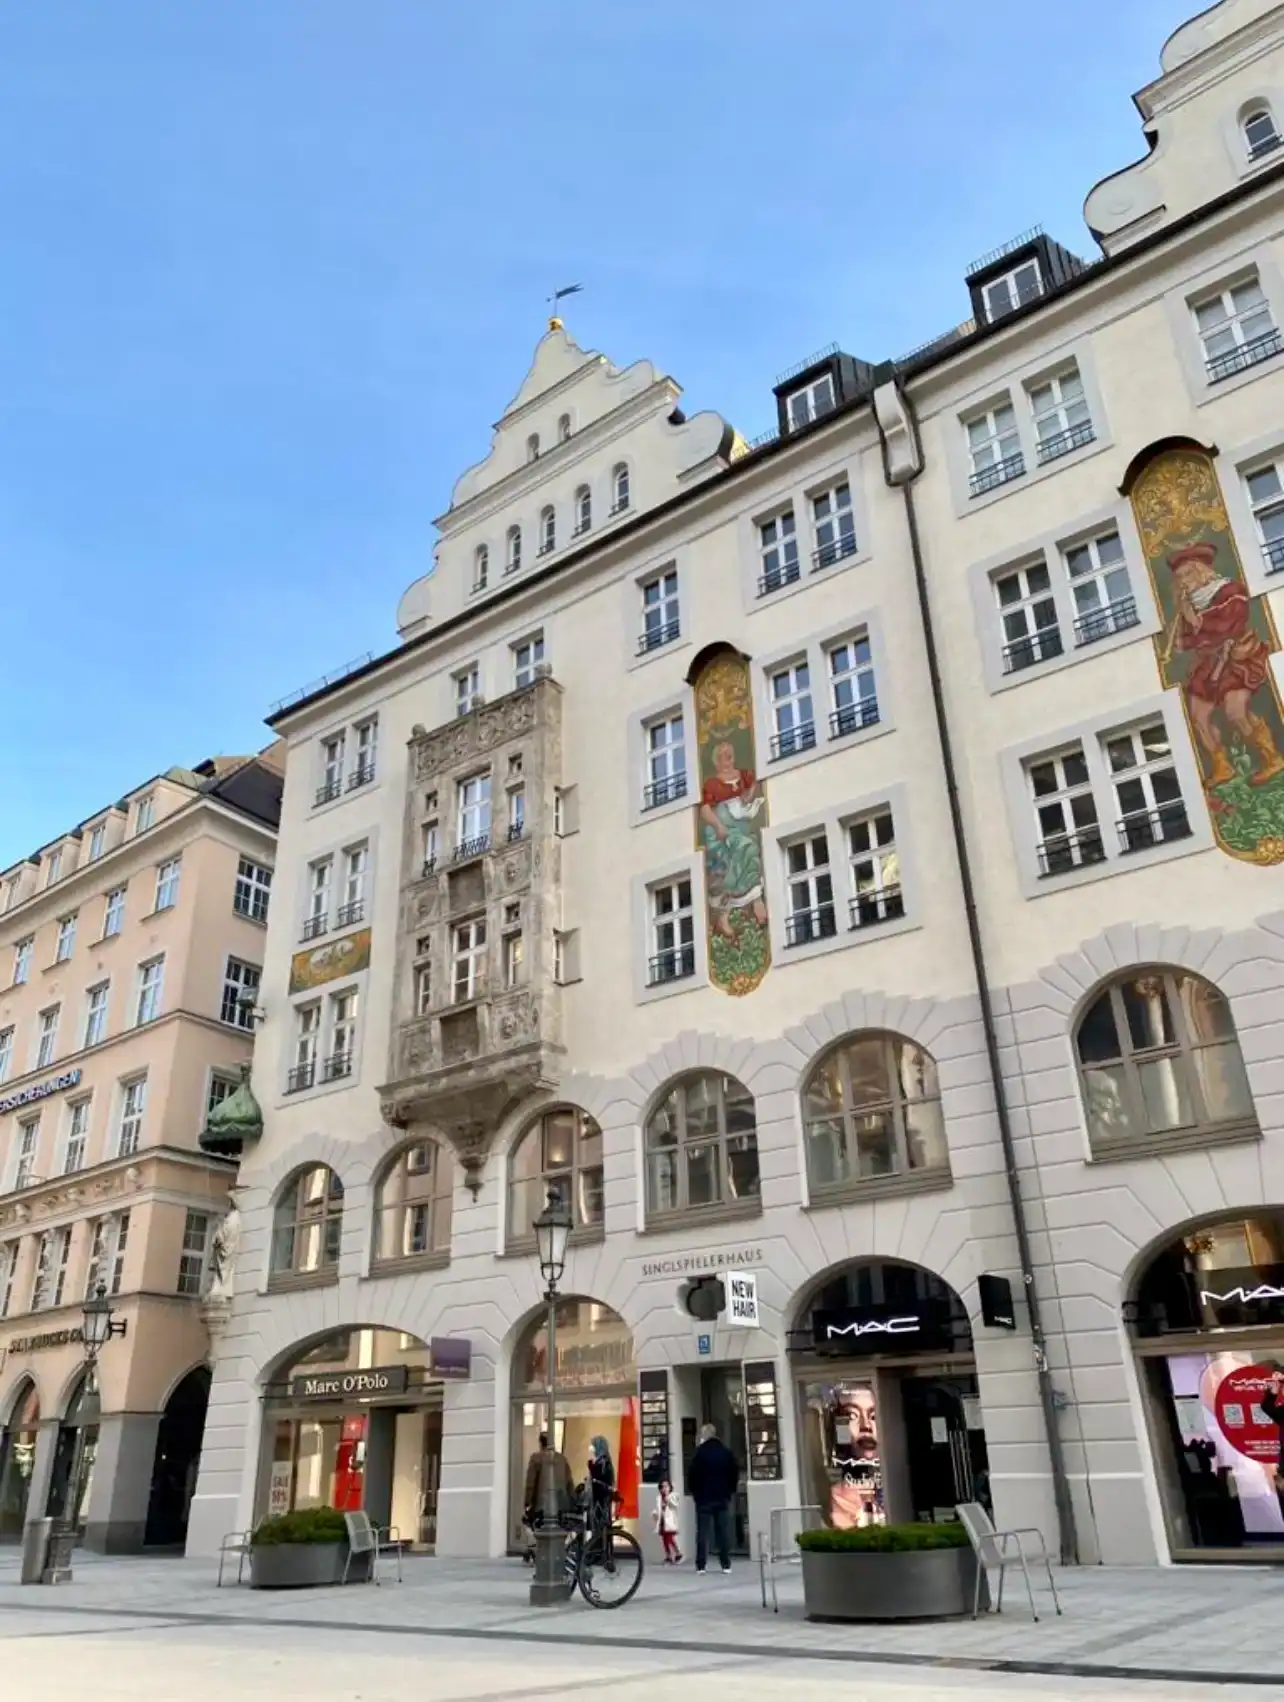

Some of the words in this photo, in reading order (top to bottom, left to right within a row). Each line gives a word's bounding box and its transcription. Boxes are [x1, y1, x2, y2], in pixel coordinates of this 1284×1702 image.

[732, 1280, 755, 1298] NEW
[733, 1300, 756, 1318] HAIR
[305, 1379, 340, 1395] Marc
[343, 1373, 389, 1391] O'Polo
